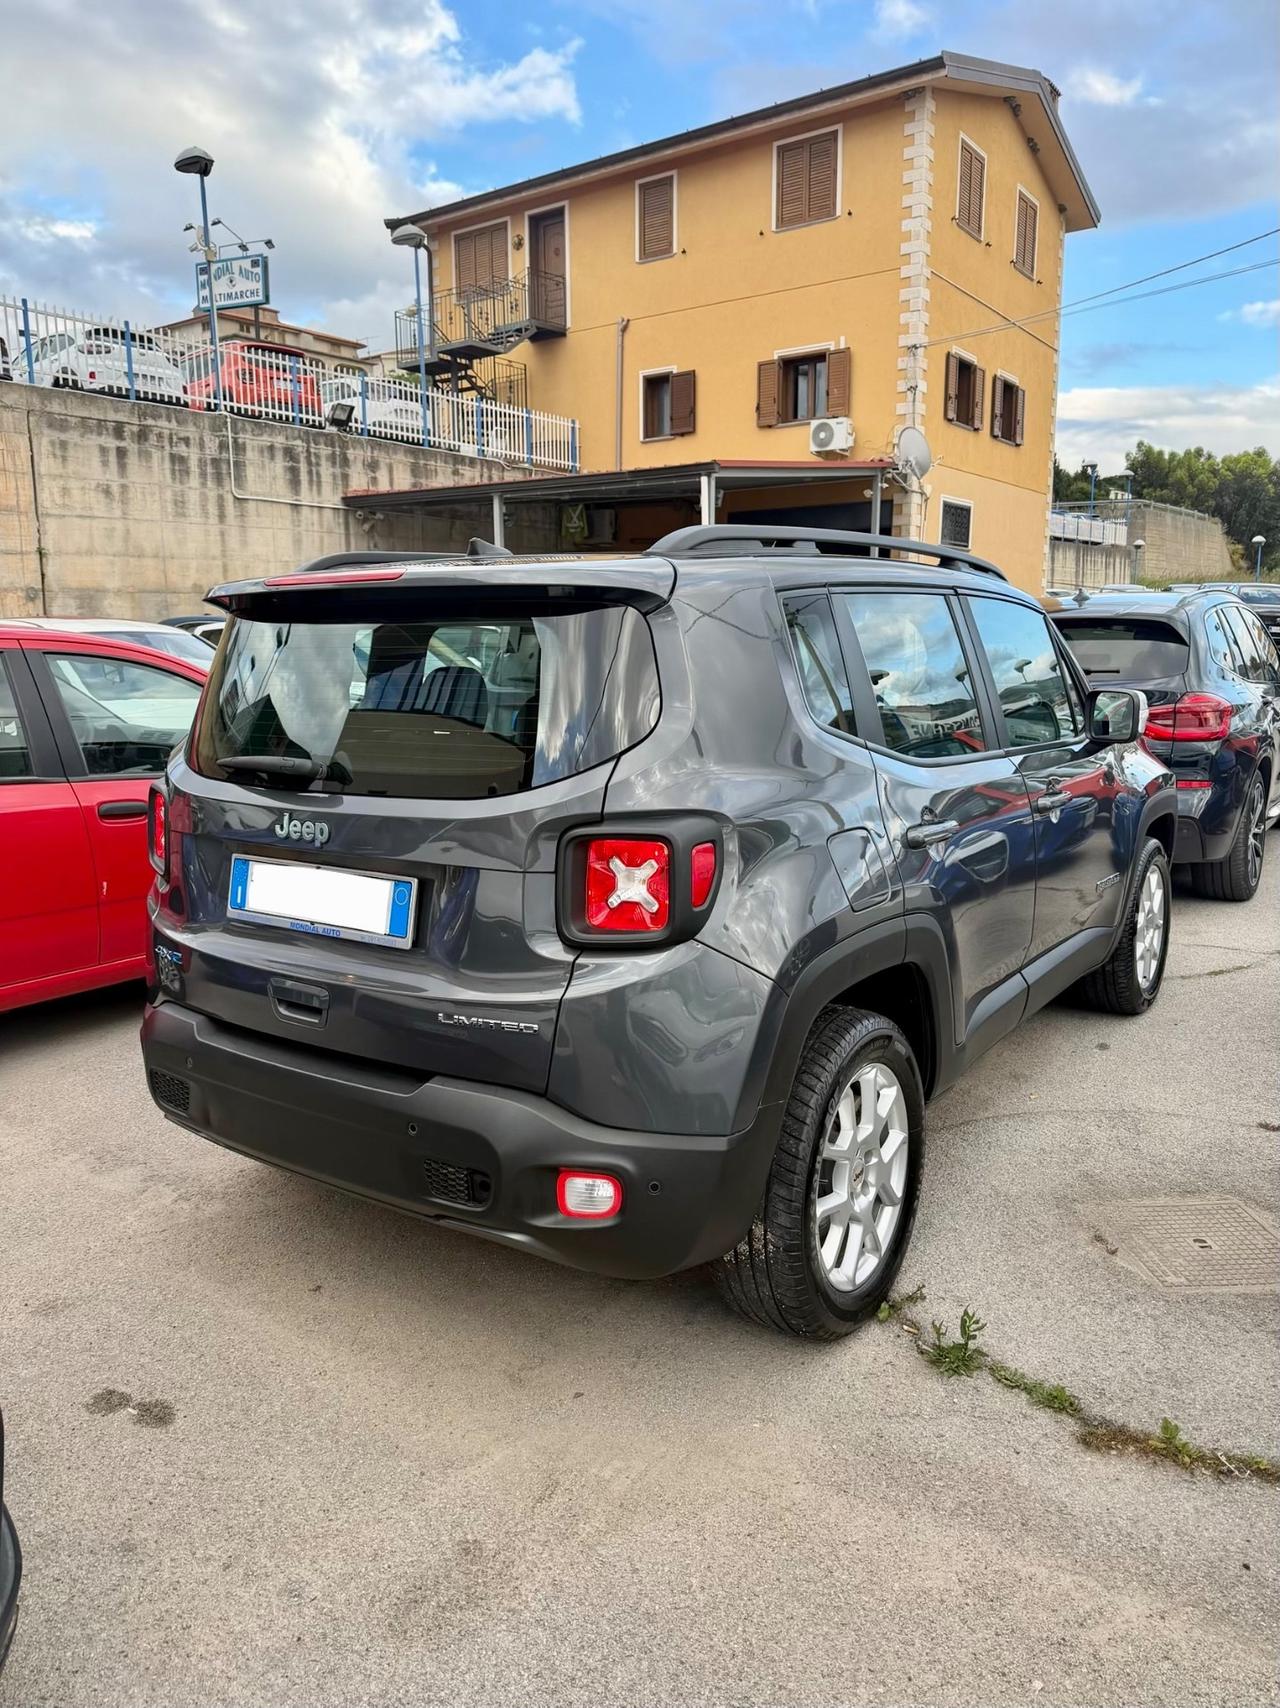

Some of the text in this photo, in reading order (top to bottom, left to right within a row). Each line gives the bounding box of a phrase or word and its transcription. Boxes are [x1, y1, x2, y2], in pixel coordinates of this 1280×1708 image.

[200, 261, 261, 290] MNDIAL AUTO
[201, 288, 260, 304] MLTIMARCHE
[274, 812, 329, 848] Jeep
[237, 885, 242, 903] I
[289, 921, 342, 938] MONDIAL AUTO
[438, 1013, 538, 1033] LIMITED
